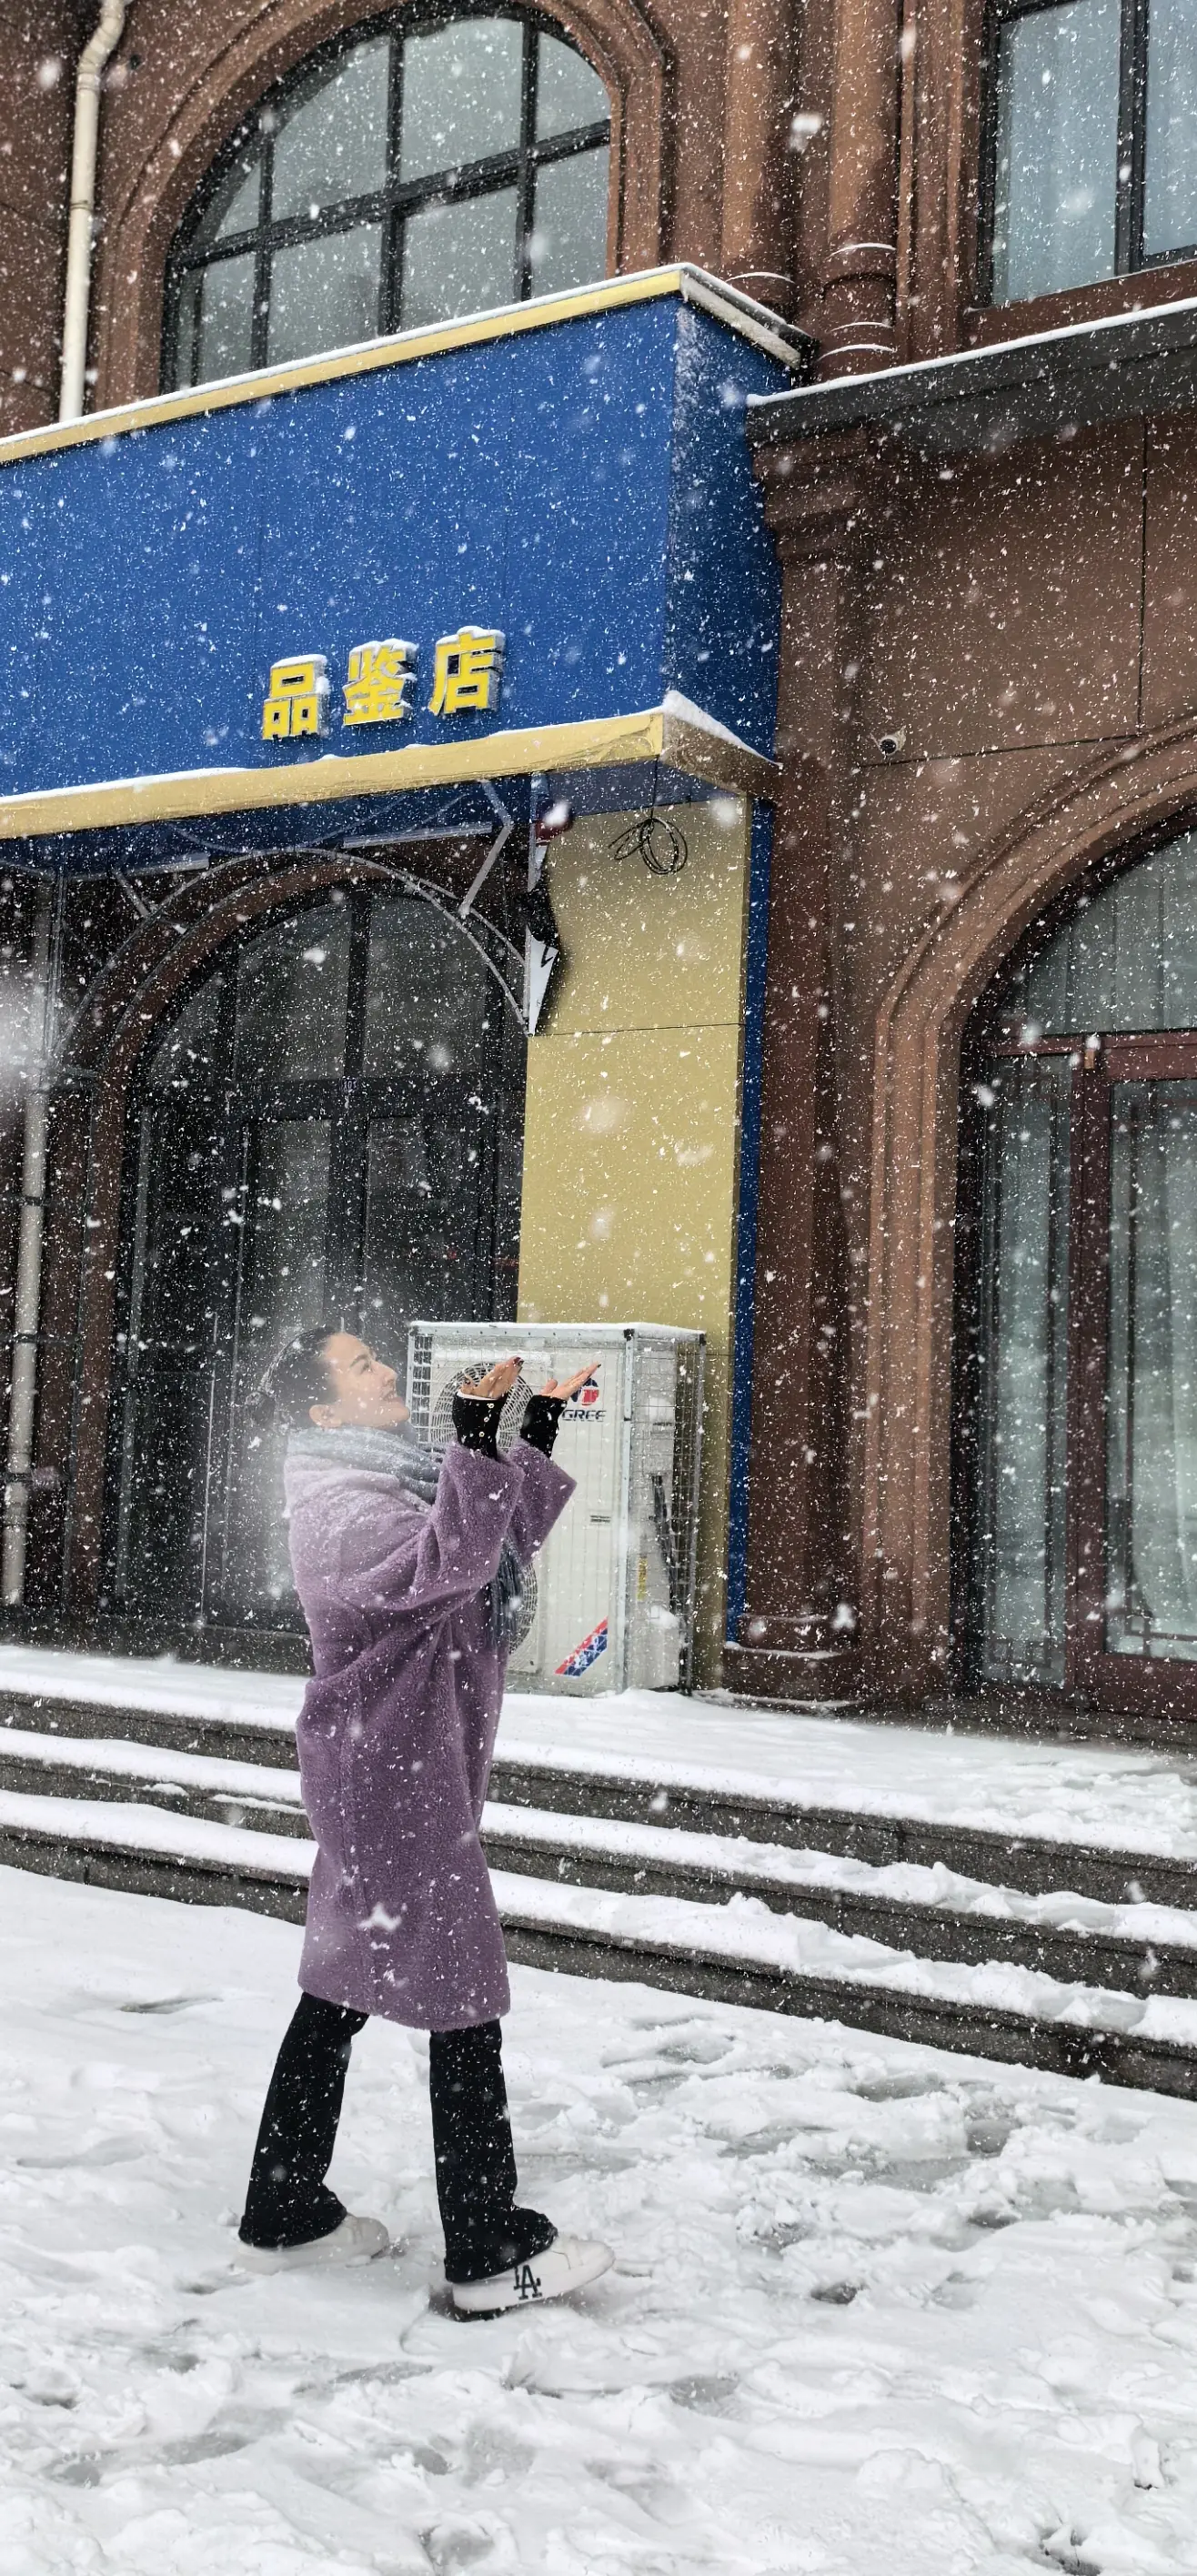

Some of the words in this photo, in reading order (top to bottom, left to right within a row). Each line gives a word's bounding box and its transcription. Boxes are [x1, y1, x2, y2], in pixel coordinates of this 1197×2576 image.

[262, 629, 503, 740] 品鉴店
[562, 1409, 607, 1422] GREE
[514, 2264, 543, 2299] LA
